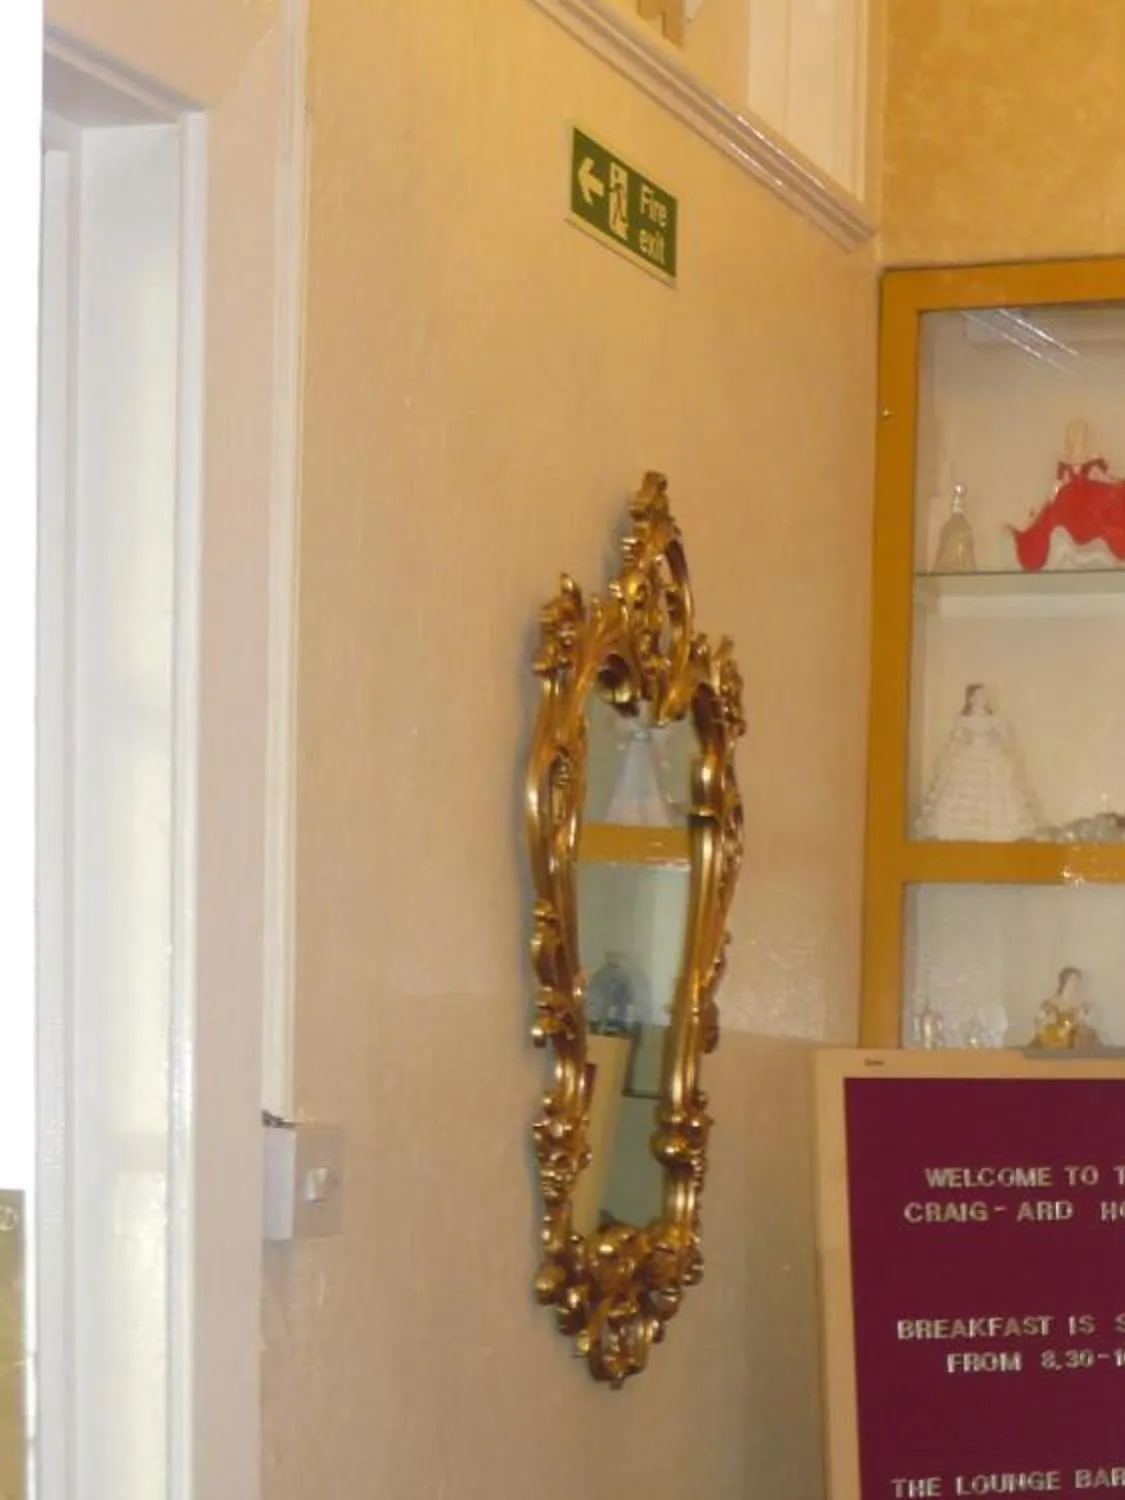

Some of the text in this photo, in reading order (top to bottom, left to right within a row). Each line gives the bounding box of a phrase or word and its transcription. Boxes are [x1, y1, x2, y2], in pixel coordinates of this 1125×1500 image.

[640, 184, 668, 227] Fire
[925, 1166, 1053, 1188] WELCOME
[1064, 1166, 1099, 1186] TO
[1017, 1200, 1074, 1221] ARD
[897, 1316, 1054, 1340] BREAKFAST
[1068, 1316, 1095, 1335] IS
[946, 1351, 1022, 1373] FROM
[892, 1478, 942, 1498] THE
[956, 1471, 1061, 1496] LOUNGE
